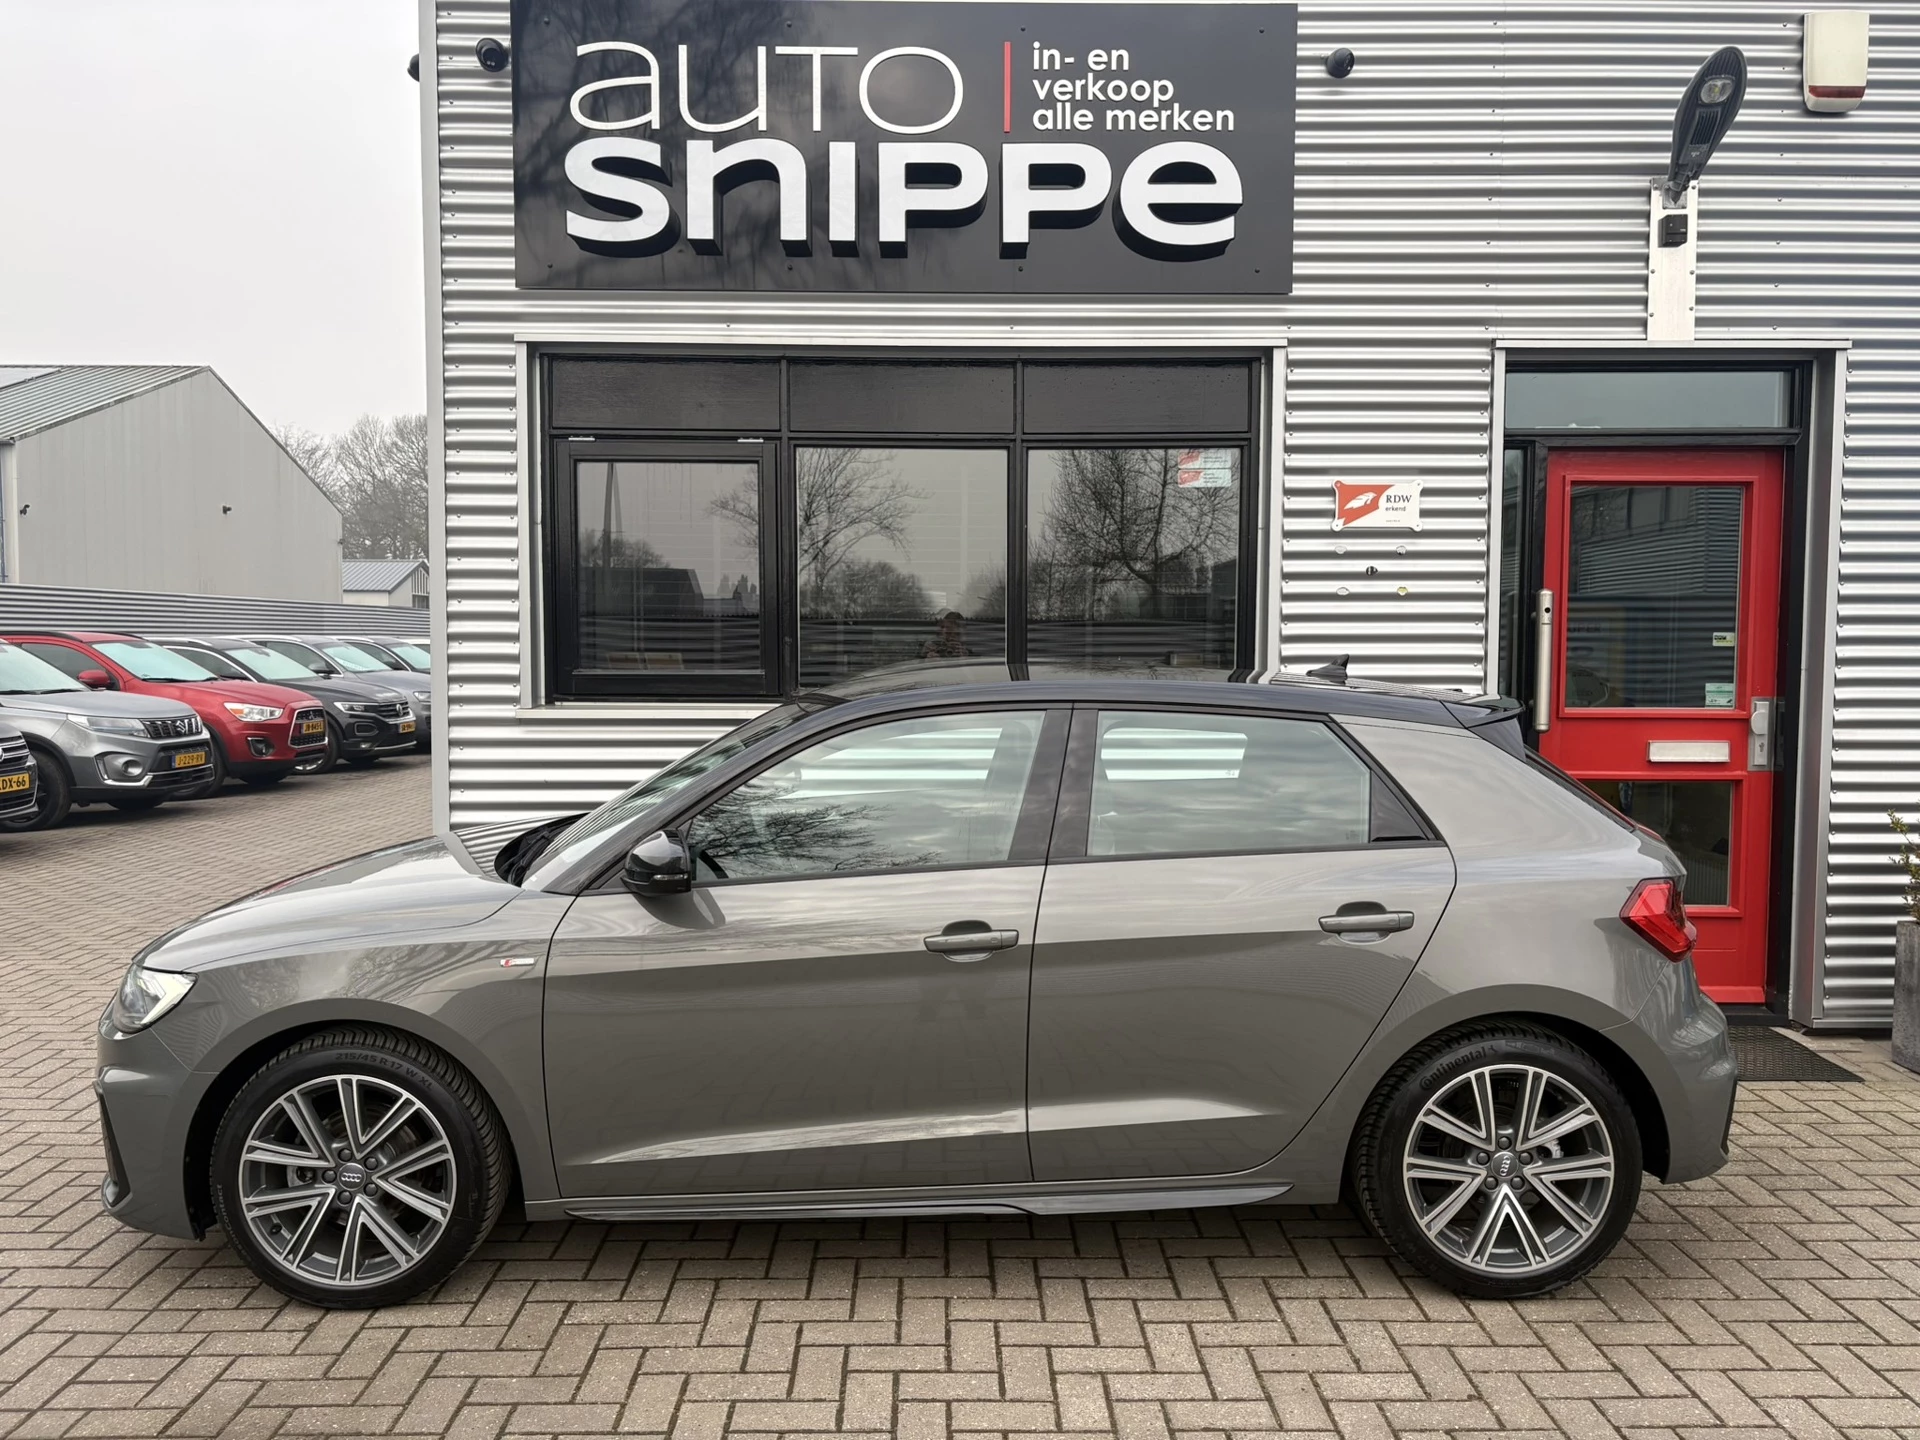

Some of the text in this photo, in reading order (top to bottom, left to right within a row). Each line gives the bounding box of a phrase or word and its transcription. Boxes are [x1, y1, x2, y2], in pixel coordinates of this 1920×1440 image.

[1032, 40, 1130, 71] in- en
[1032, 72, 1175, 108] verkoop
[1032, 102, 1235, 131] alle merken
[1385, 494, 1412, 504] RDW
[335, 1052, 377, 1063] 215/45
[1419, 1045, 1487, 1091] Continental
